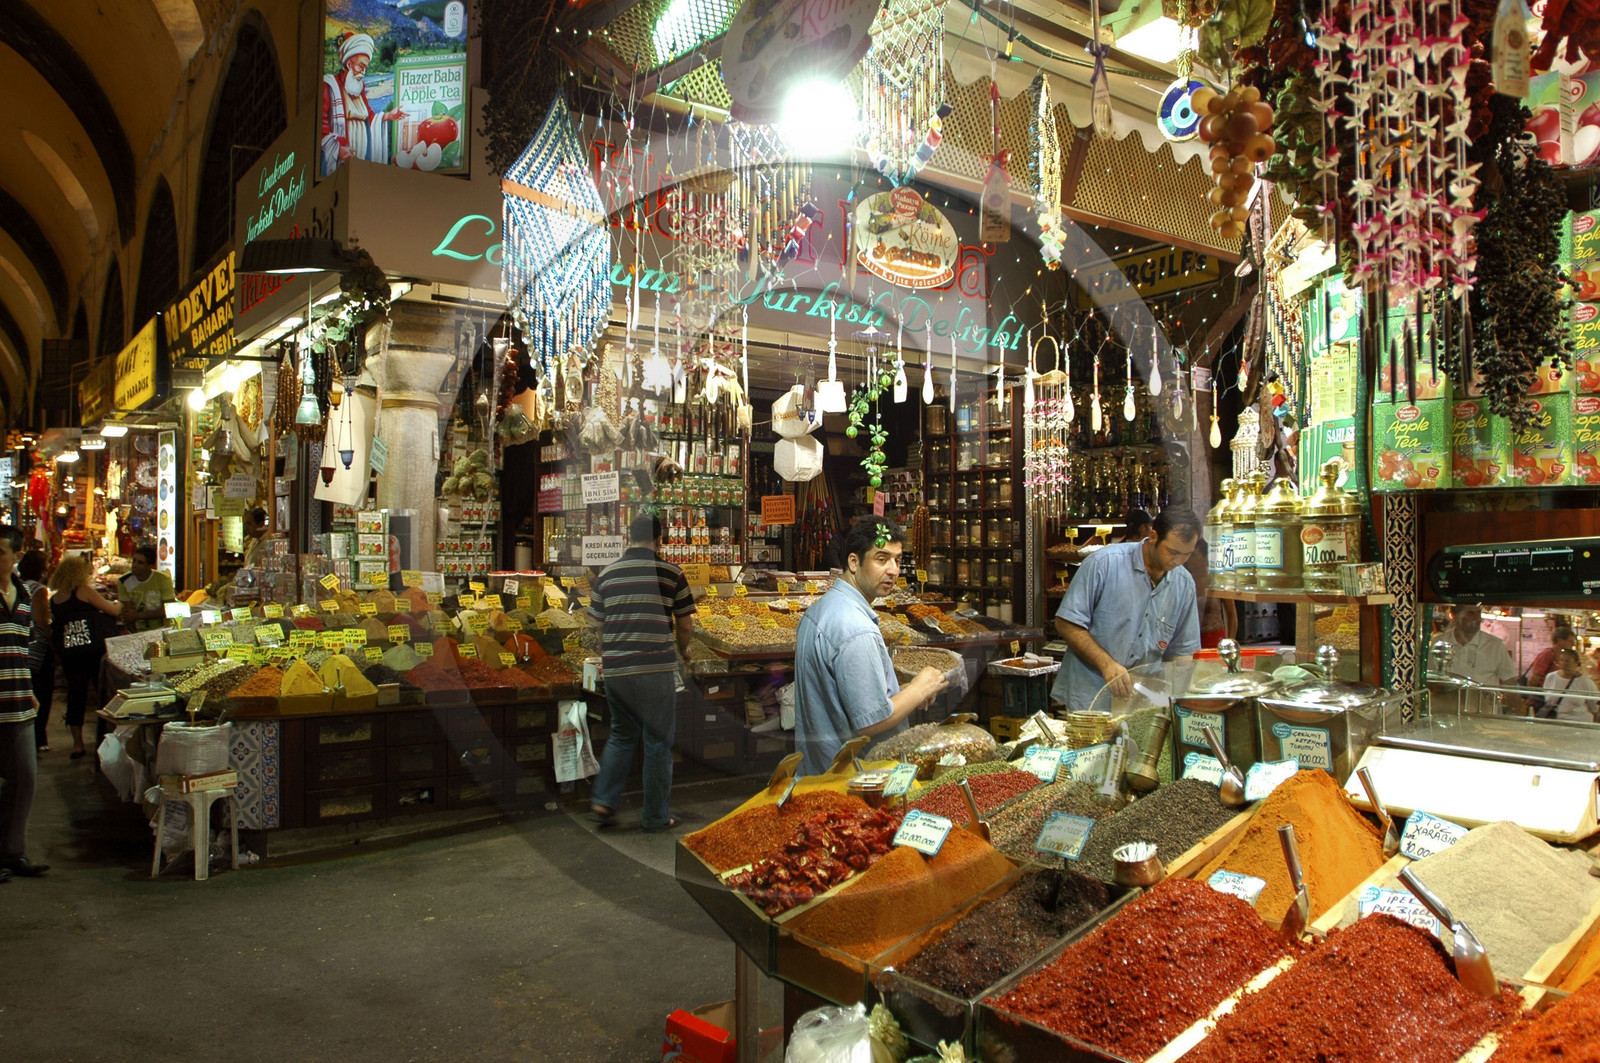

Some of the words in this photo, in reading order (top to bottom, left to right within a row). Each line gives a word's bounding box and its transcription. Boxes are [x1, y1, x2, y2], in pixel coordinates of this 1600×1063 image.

[402, 72, 432, 85] Hazer
[434, 69, 461, 83] Baba
[401, 86, 436, 104] Apple
[440, 85, 461, 98] Tea
[258, 151, 295, 199] Loukoum
[244, 194, 276, 246] Turkish
[908, 224, 951, 250] Köme
[191, 296, 235, 348] BAHARA
[728, 269, 885, 327] Turkish
[899, 295, 1025, 353] Delight
[1386, 417, 1430, 436] Apple
[1395, 435, 1422, 448] Tea
[1425, 816, 1452, 834] TOZ
